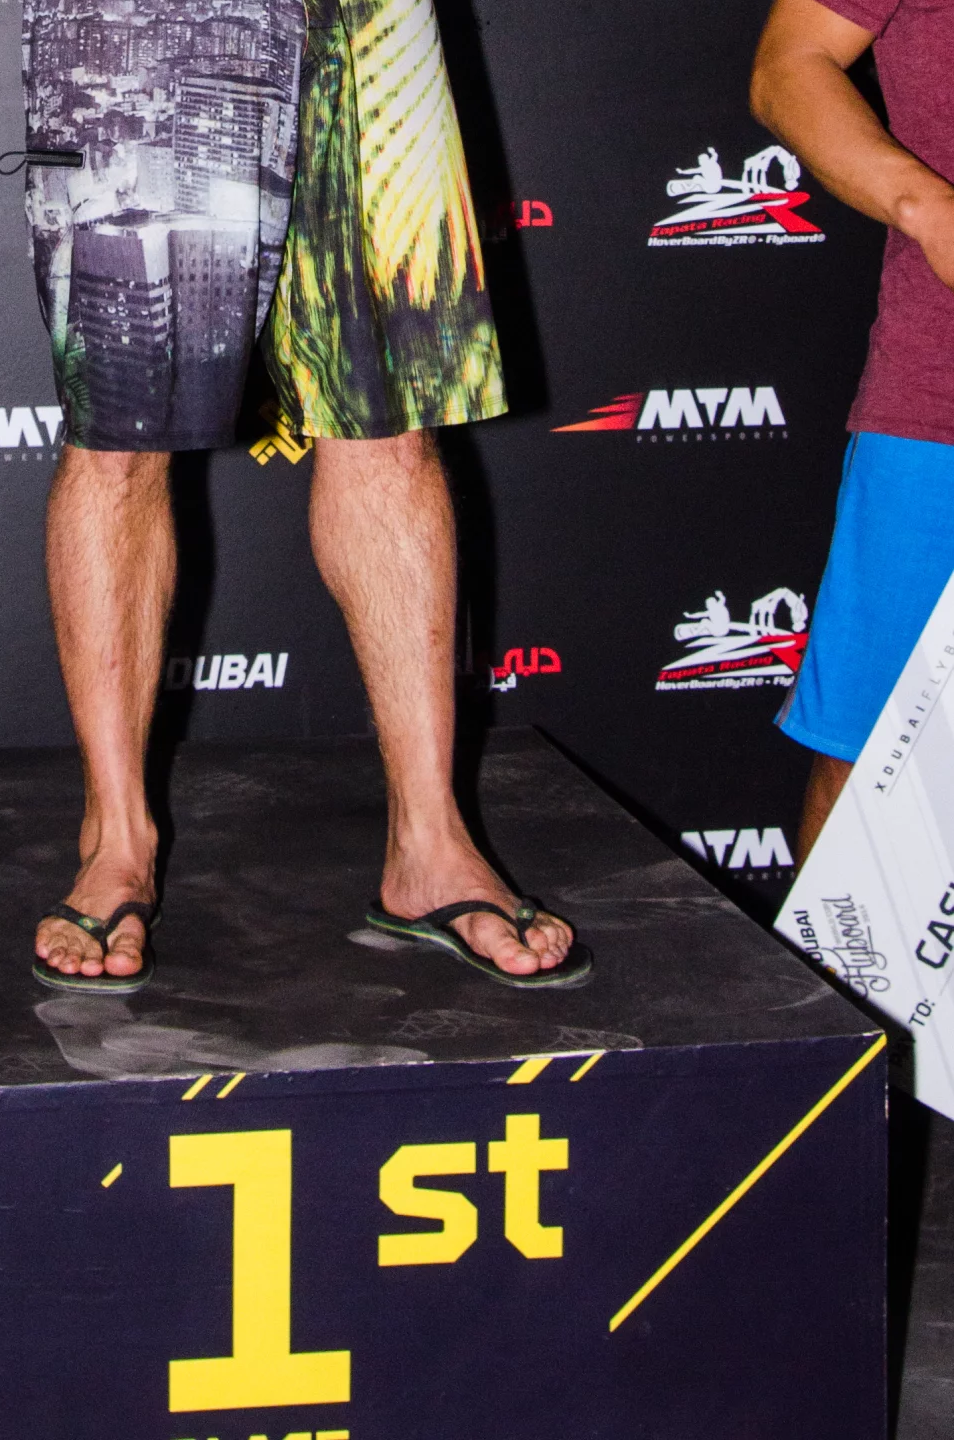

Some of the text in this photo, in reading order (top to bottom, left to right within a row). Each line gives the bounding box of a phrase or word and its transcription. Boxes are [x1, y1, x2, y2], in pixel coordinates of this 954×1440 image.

[637, 386, 786, 430] MTM
[636, 430, 788, 443] POWERSPORTS
[909, 998, 936, 1027] TO:
